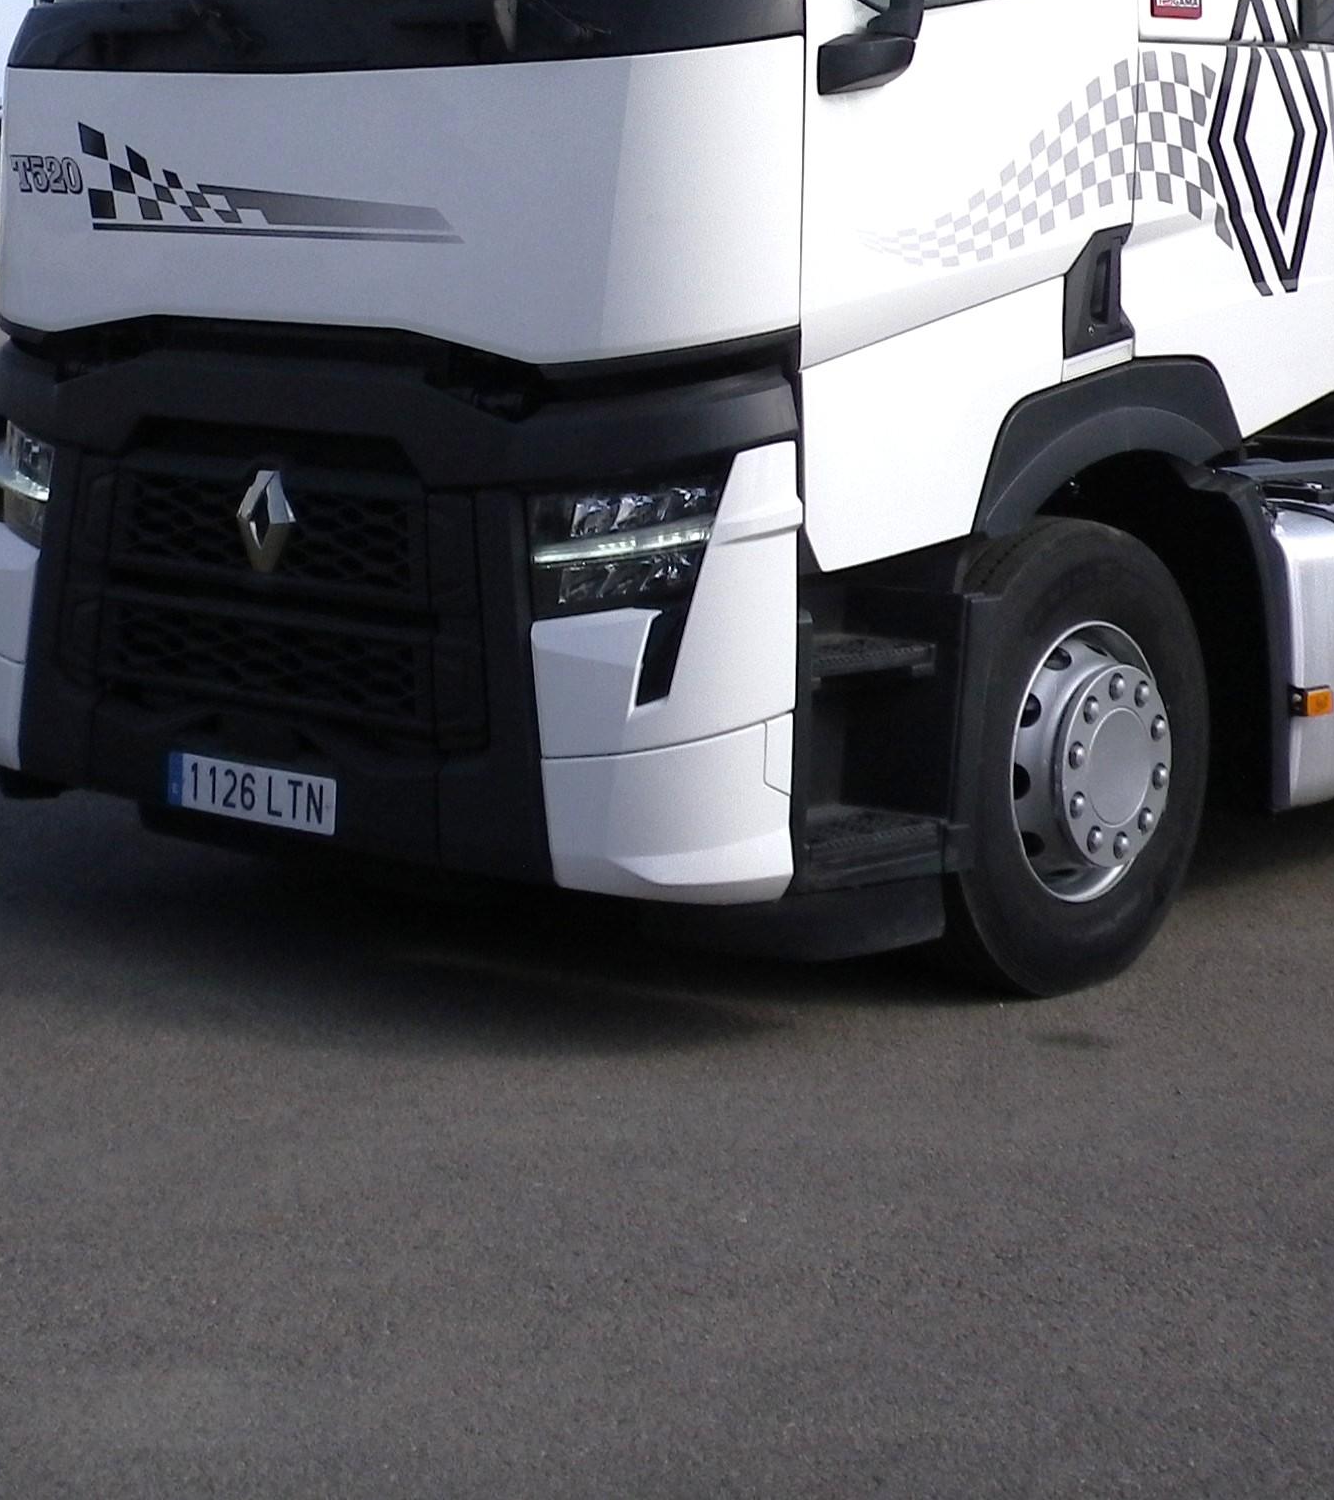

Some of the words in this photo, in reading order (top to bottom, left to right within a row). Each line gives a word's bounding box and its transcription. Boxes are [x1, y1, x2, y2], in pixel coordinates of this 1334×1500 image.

[10, 154, 84, 195] T520
[190, 761, 257, 812] 1126
[266, 774, 325, 826] LTN
